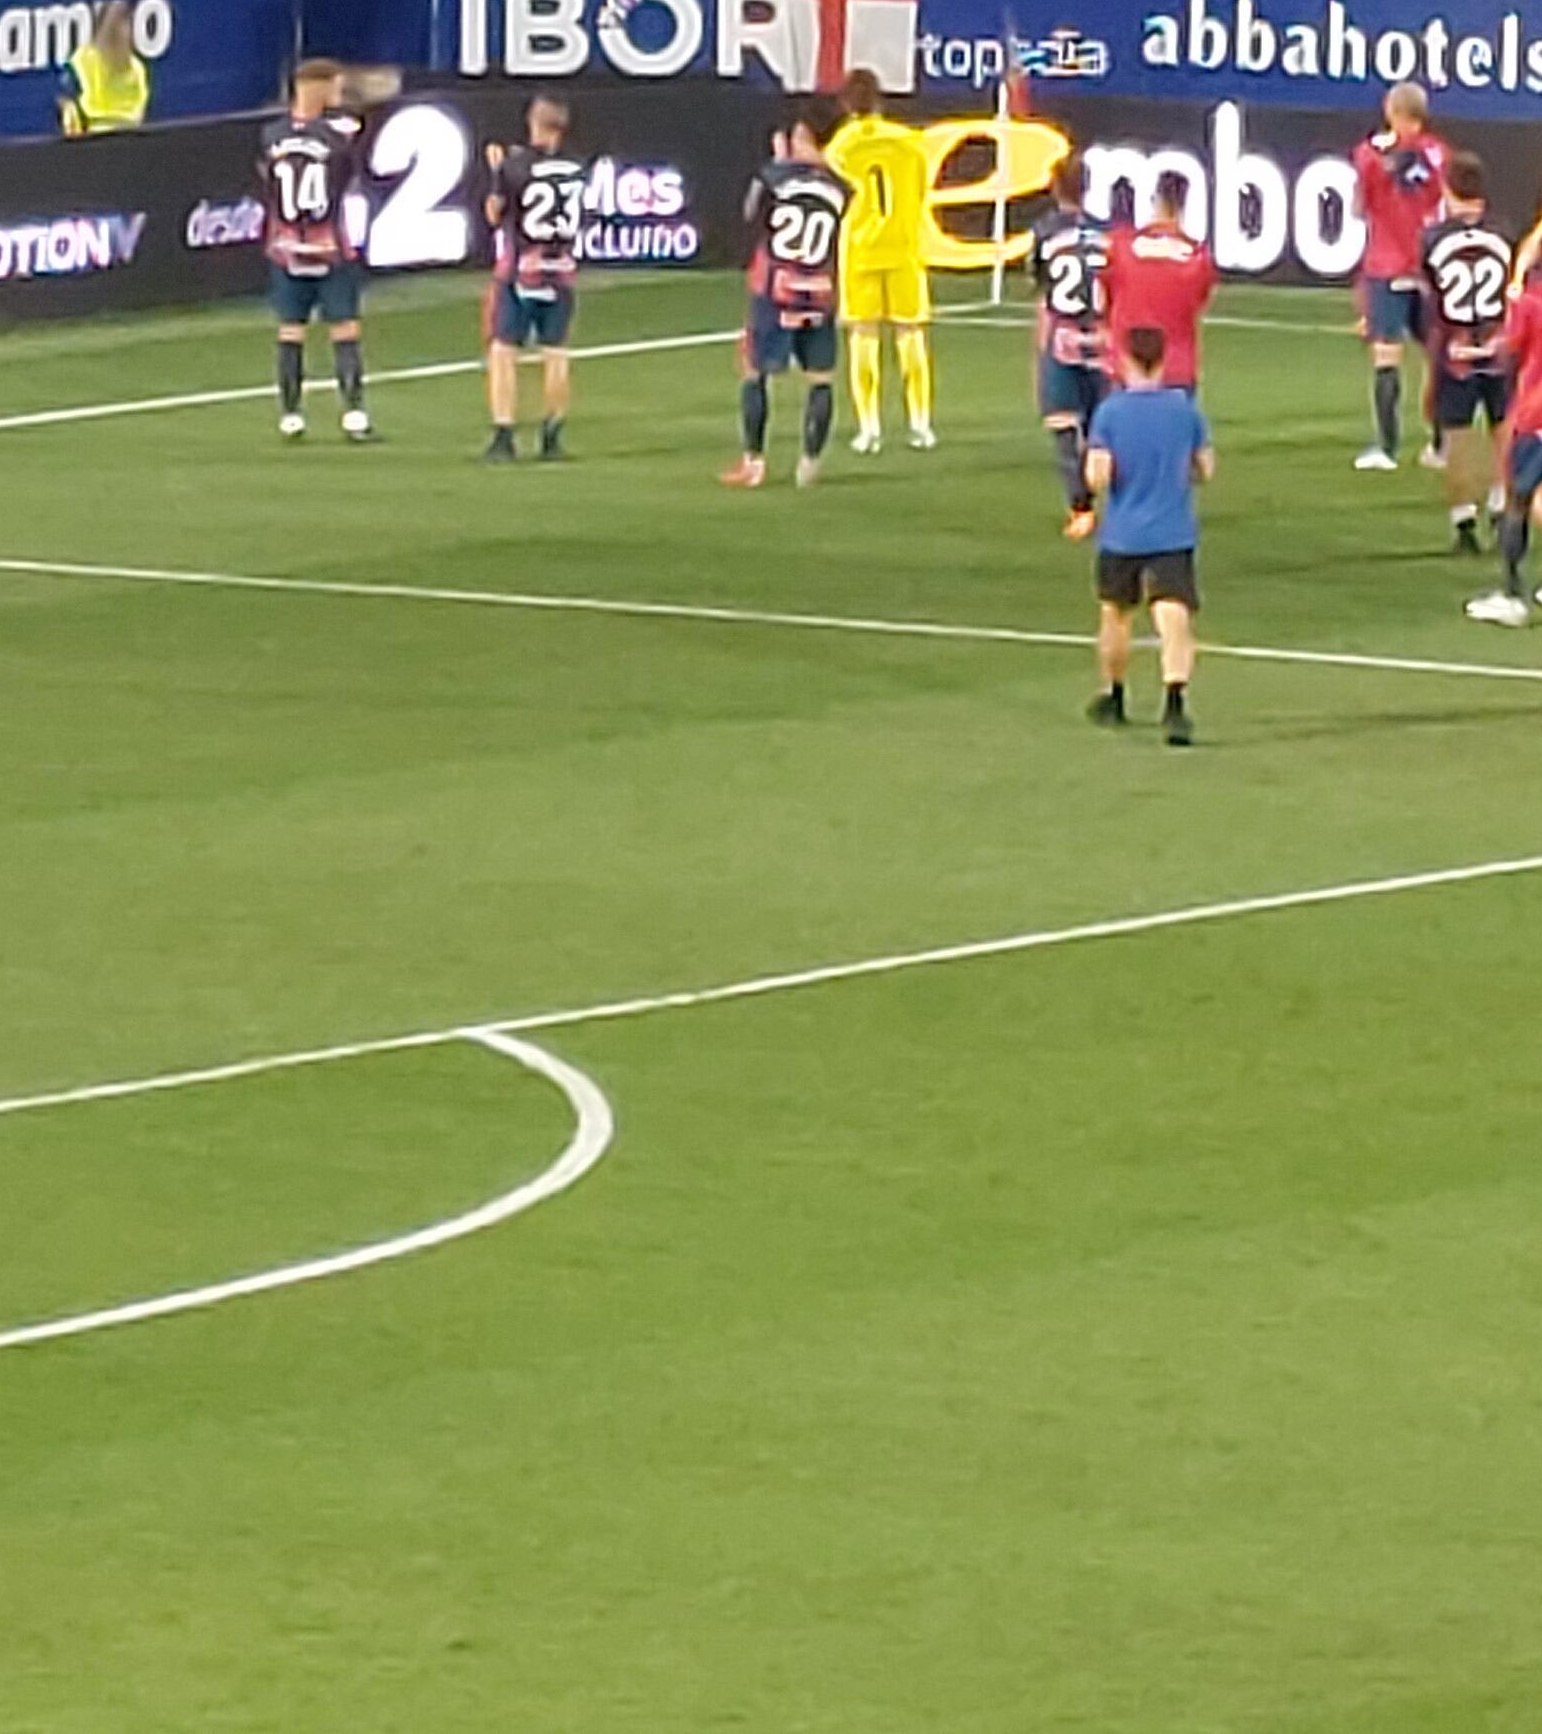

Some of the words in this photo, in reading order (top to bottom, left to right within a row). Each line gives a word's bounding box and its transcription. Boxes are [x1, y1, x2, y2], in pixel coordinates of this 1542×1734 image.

[271, 161, 328, 222] 14
[521, 180, 583, 241] 23
[867, 164, 888, 218] 1
[770, 205, 836, 265] 20
[1438, 255, 1506, 323] 22
